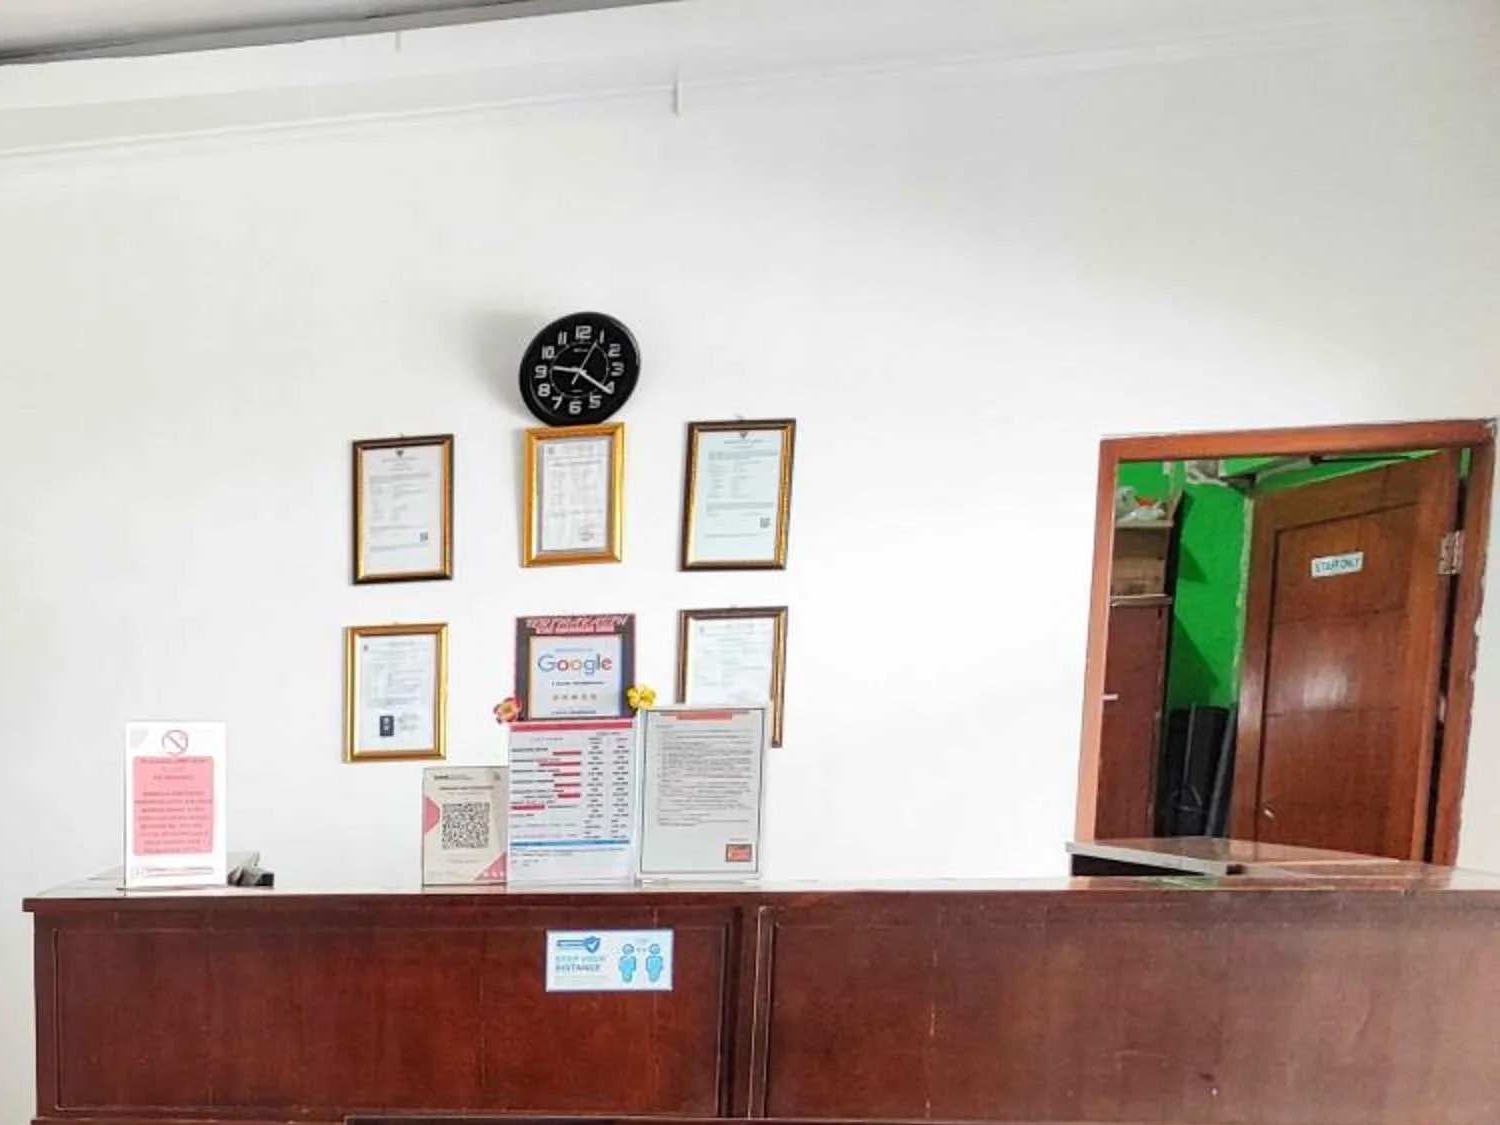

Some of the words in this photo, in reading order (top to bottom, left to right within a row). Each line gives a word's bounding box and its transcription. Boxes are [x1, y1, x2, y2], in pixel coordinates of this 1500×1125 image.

[557, 330, 567, 345] 11
[575, 325, 592, 340] 12
[541, 345, 555, 360] 10
[608, 343, 621, 357] 2
[534, 365, 547, 379] 9
[610, 361, 625, 377] 3
[538, 383, 551, 397] 8
[551, 395, 563, 410] 7
[569, 401, 582, 414] 6
[588, 394, 602, 409] 5
[537, 652, 613, 677] Google
